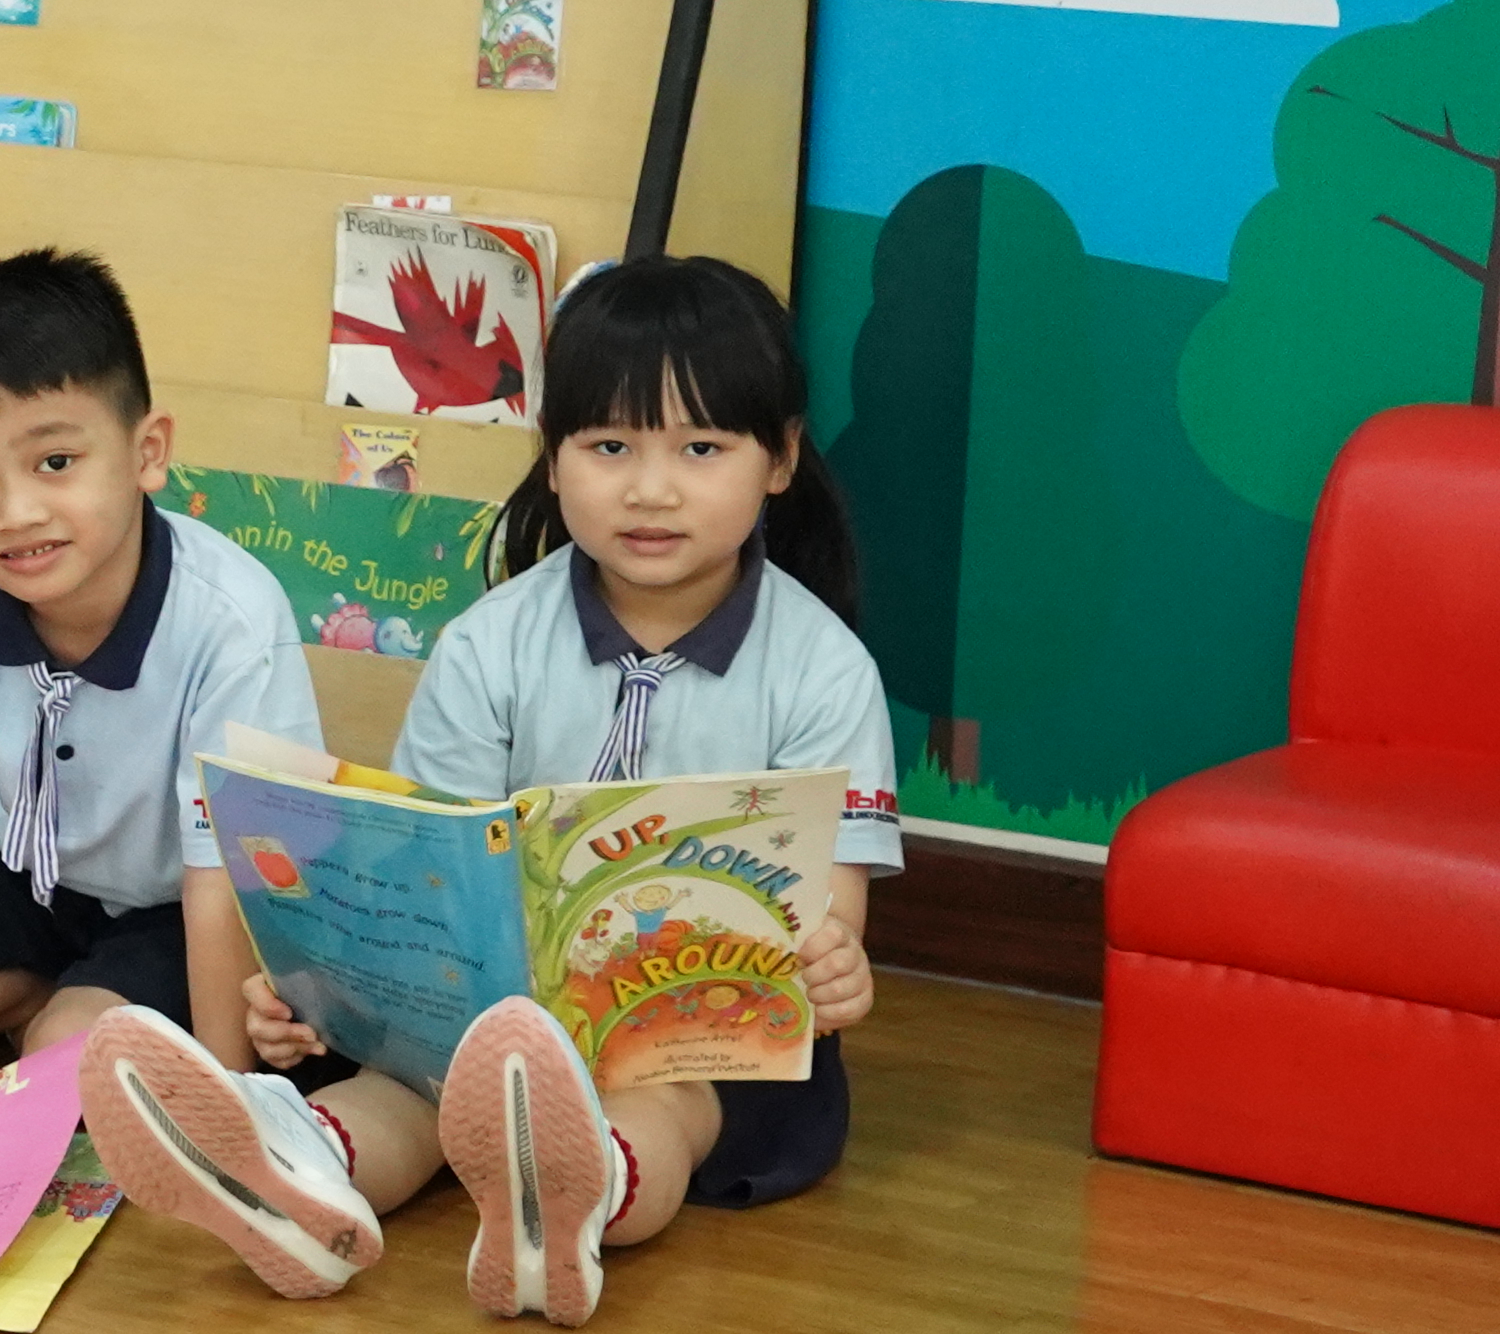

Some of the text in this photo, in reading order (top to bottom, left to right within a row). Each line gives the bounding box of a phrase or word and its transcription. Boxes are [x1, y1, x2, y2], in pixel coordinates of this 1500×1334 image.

[344, 211, 428, 244] Feathers
[432, 223, 459, 248] for
[265, 520, 293, 551] in
[303, 539, 348, 576] the
[354, 559, 449, 610] Jungle
[588, 814, 669, 862] UP,
[612, 942, 801, 1006] AROUND
